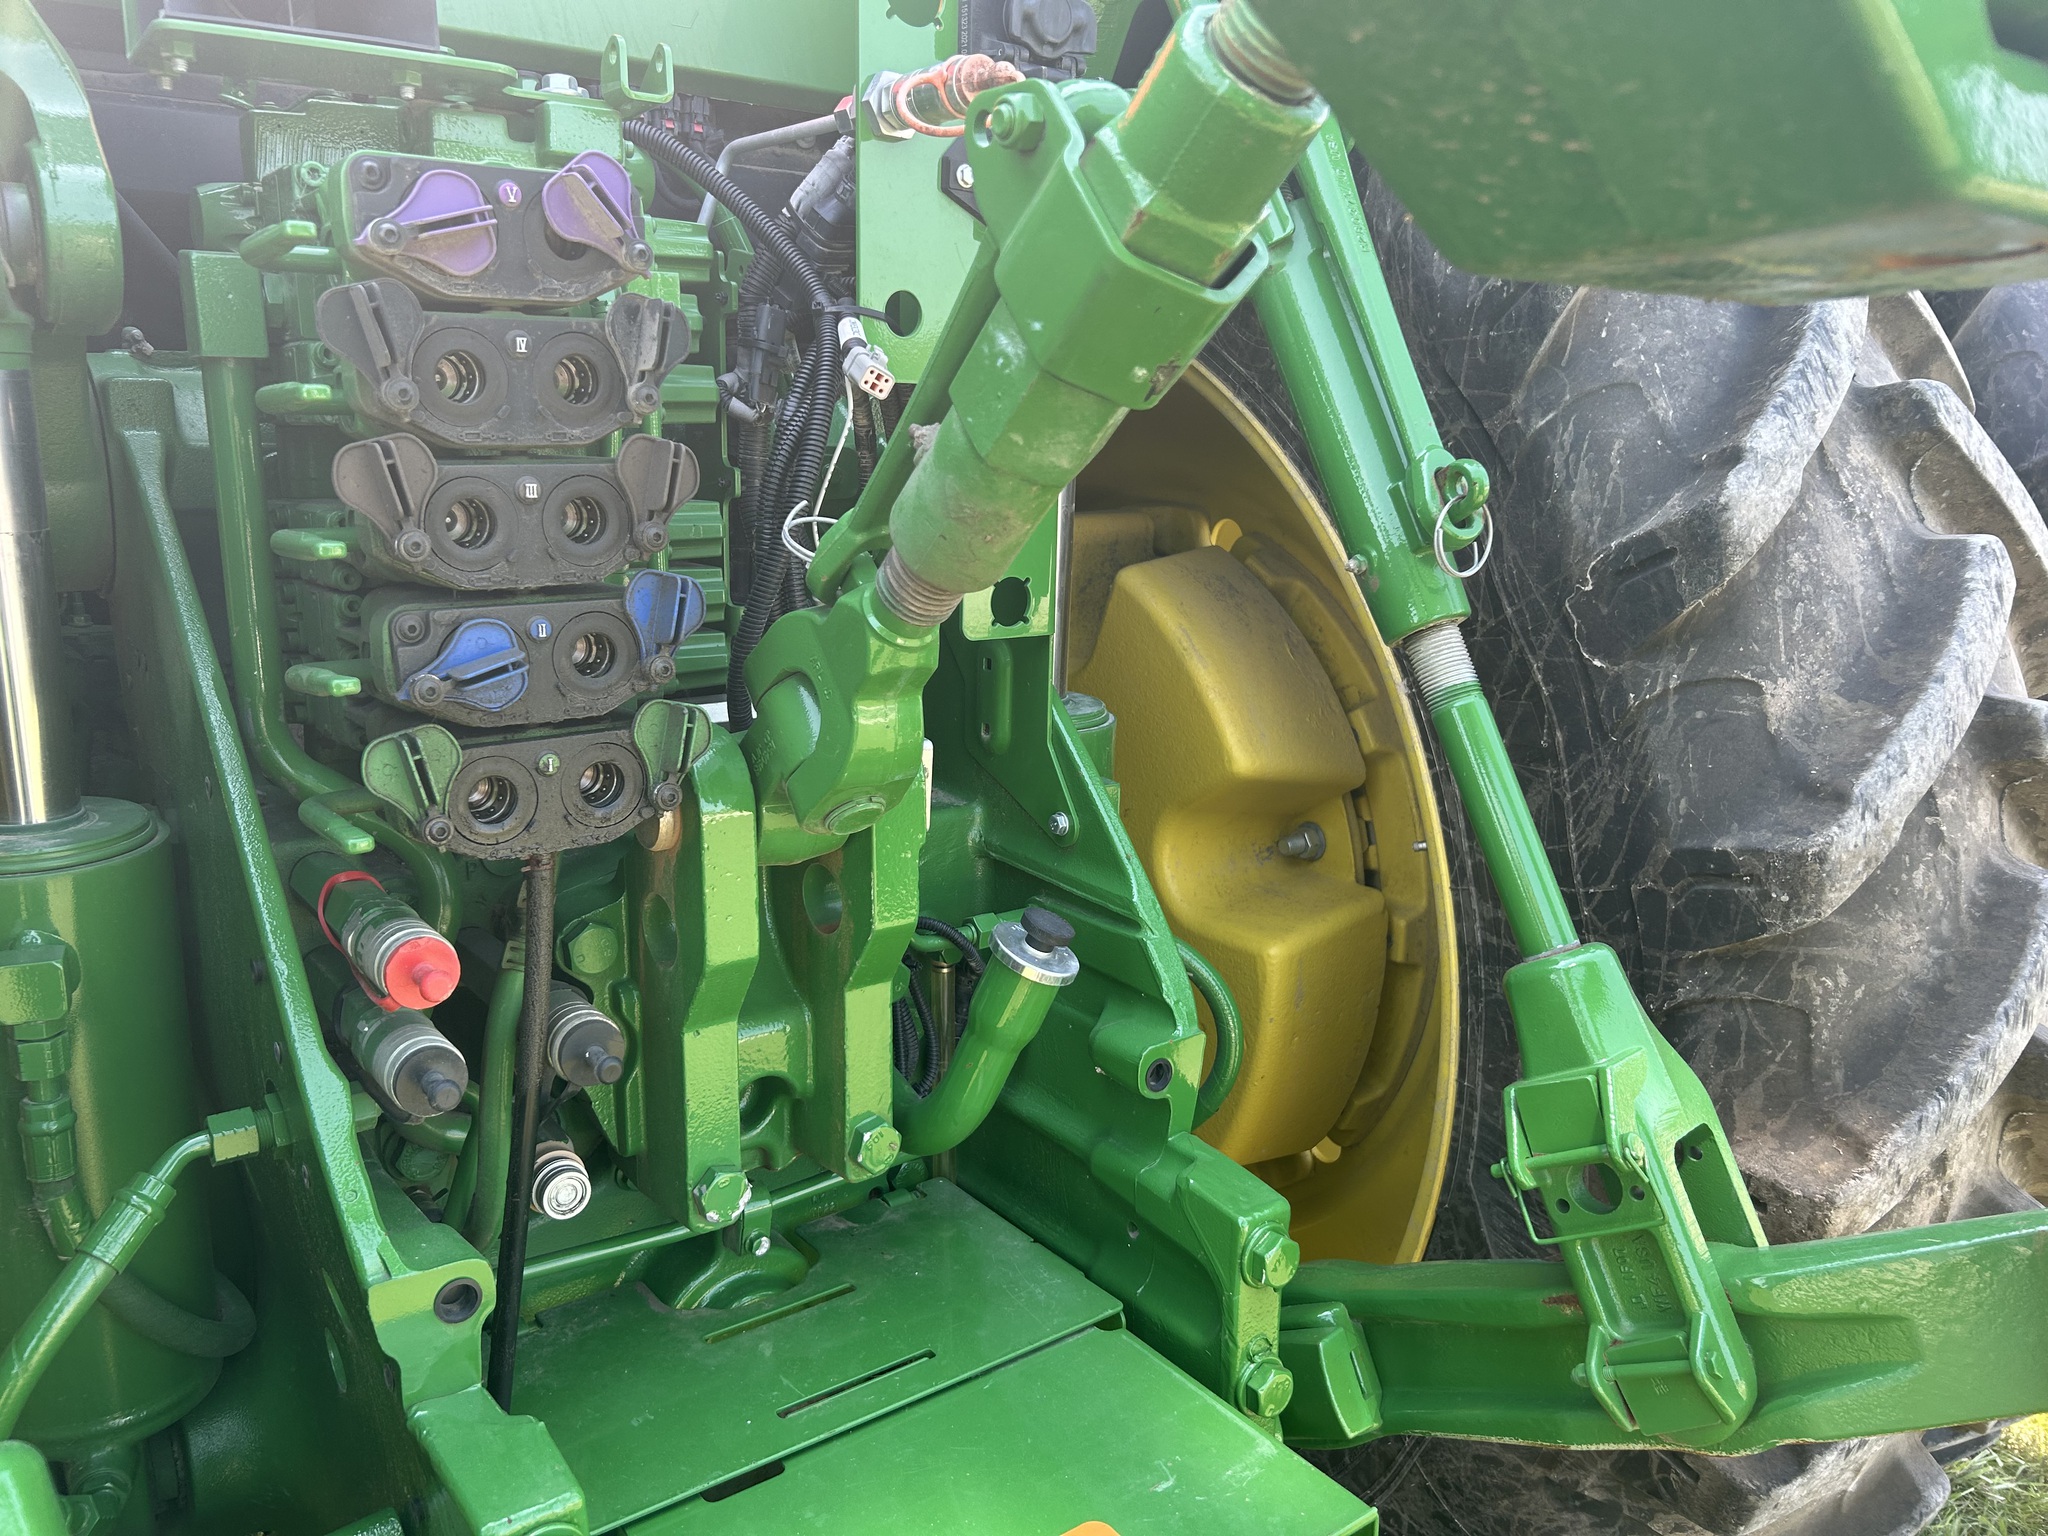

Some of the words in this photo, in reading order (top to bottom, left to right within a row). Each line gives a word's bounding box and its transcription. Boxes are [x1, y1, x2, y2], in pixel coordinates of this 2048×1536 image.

[506, 187, 519, 203] V
[517, 337, 527, 352] IV
[525, 484, 537, 498] III
[538, 623, 547, 638] II
